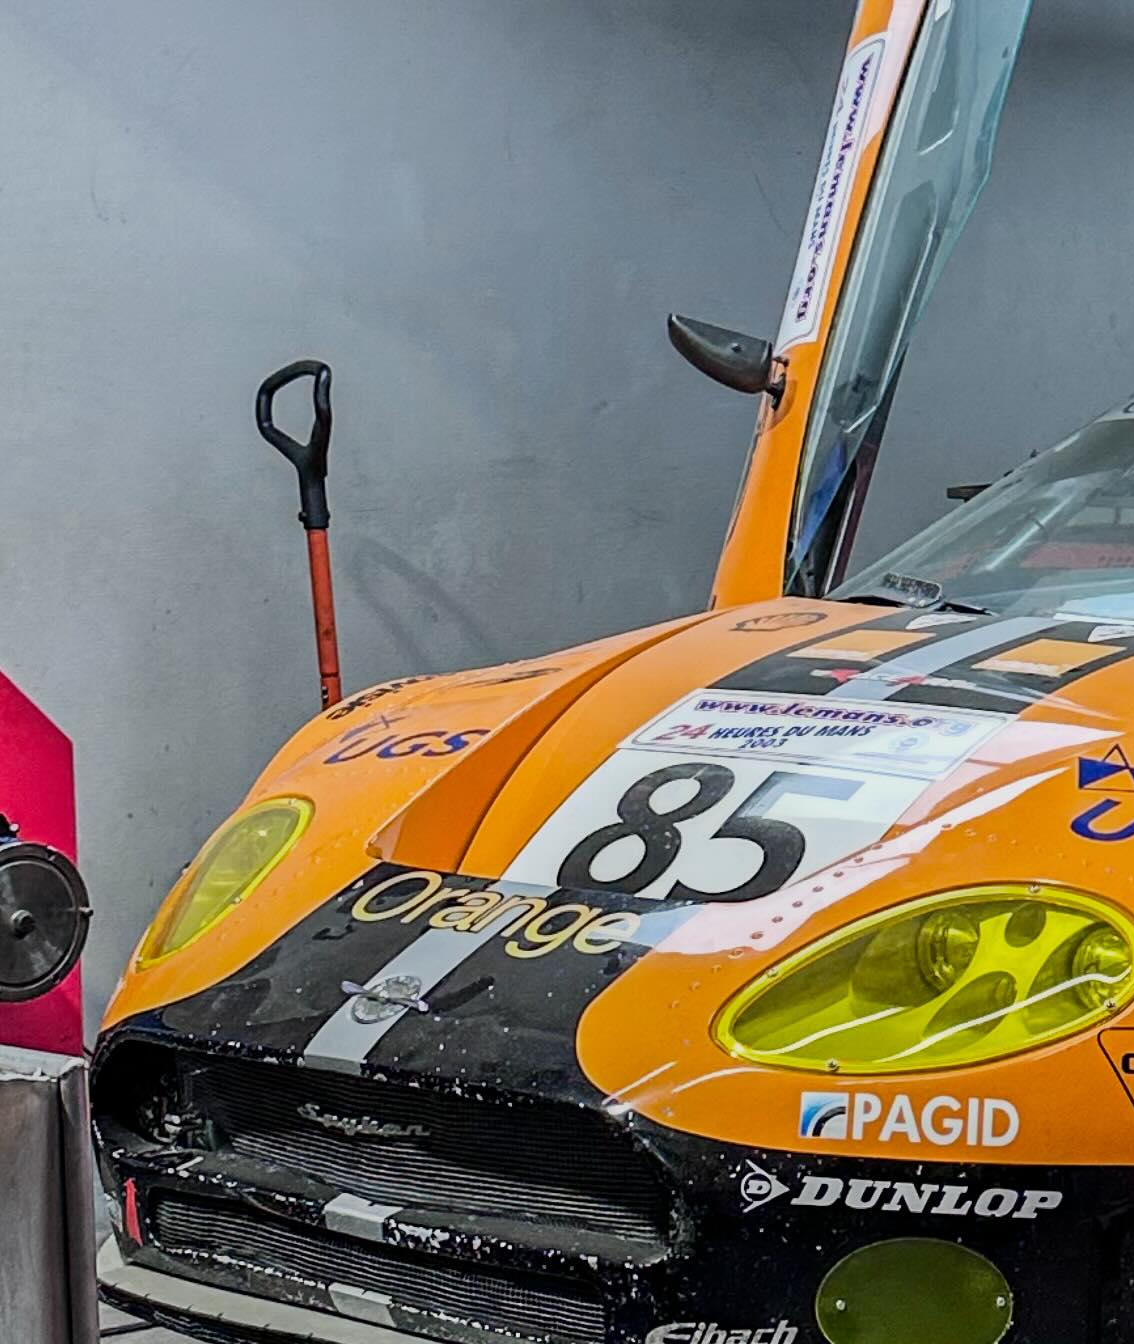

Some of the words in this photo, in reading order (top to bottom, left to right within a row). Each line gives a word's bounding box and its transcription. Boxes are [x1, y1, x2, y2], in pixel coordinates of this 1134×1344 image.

[322, 728, 492, 765] UGS
[651, 723, 715, 741] 24
[708, 726, 782, 740] HEURES
[786, 725, 816, 737] DU
[814, 725, 876, 738] MANS
[737, 738, 788, 750] 2003
[556, 761, 865, 904] 85
[350, 869, 641, 959] Orange
[851, 1093, 1020, 1147] PAGID
[790, 1175, 1064, 1219] DUNLOP
